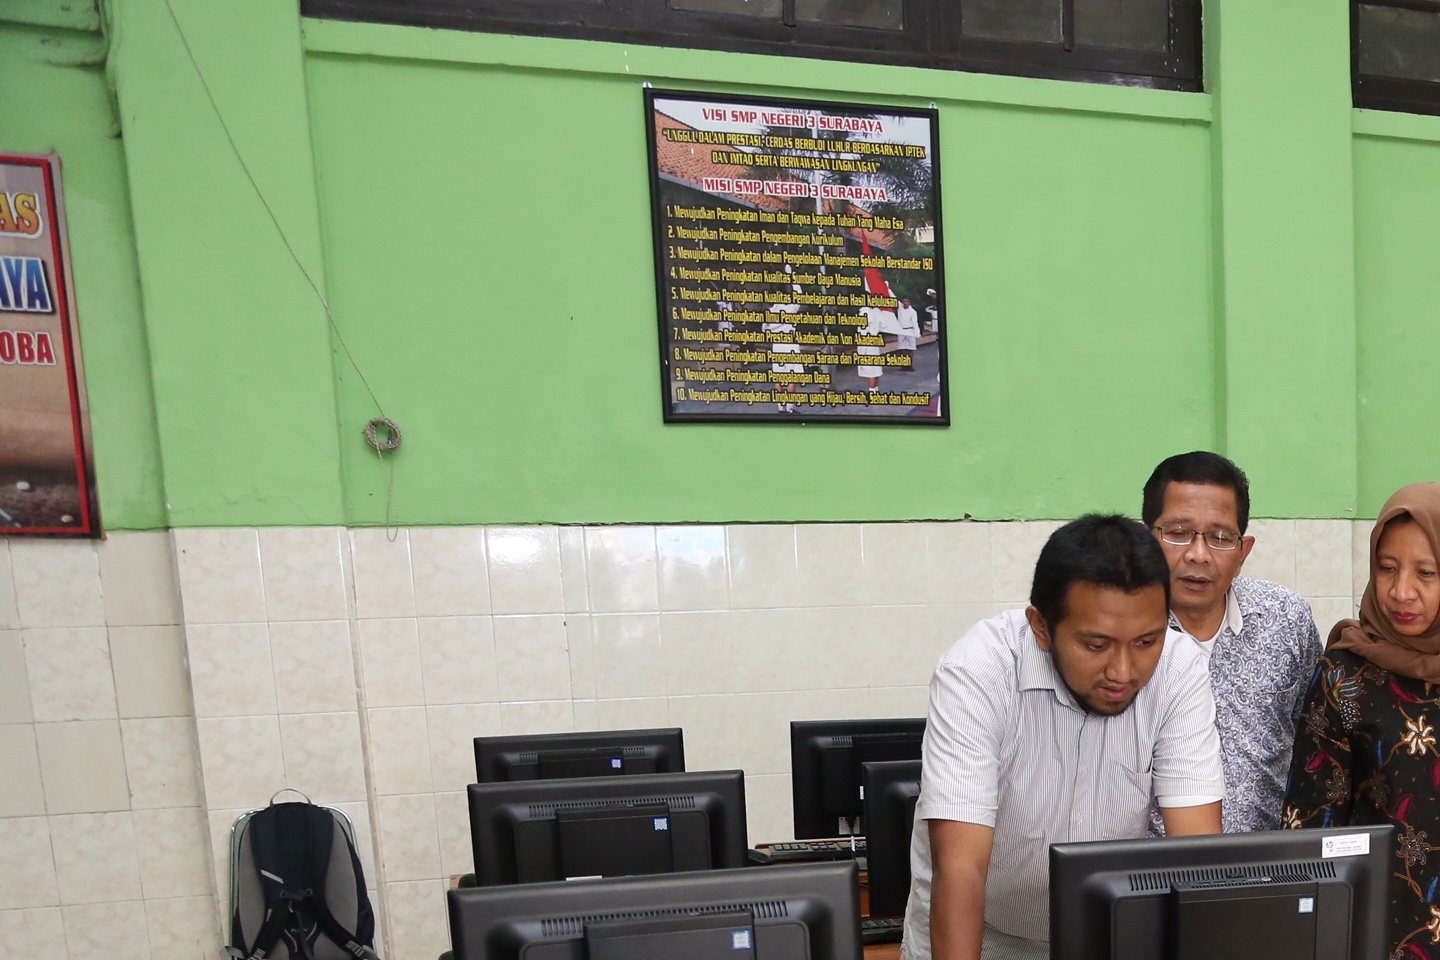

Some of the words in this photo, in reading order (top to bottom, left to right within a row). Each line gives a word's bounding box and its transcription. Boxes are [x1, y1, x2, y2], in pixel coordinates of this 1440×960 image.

[702, 108, 727, 121] VISI
[731, 110, 757, 123] SMP
[761, 112, 804, 127] NEGERI
[807, 115, 815, 128] 3
[819, 117, 884, 133] SURABAYA
[699, 130, 725, 144] DALAM
[765, 136, 793, 149] CERDAS
[795, 138, 826, 151] BERBUDI
[827, 140, 851, 153] LUHUR
[852, 141, 904, 157] BERDASARKAN
[905, 146, 926, 158] IPTEK
[712, 151, 728, 164] DAN
[755, 155, 778, 167] SERTA
[780, 156, 830, 170] BERWAWASAN
[704, 178, 731, 192] MISI
[735, 180, 761, 193] SMP
[765, 182, 807, 197] NEGERI
[811, 185, 819, 197] 3
[822, 186, 887, 201] SURABAYA
[667, 205, 673, 218] 1.
[674, 205, 716, 222] Mewujudkan
[716, 207, 758, 224] Peningkatan
[759, 210, 776, 223] Iman
[776, 211, 790, 223] dan
[790, 212, 811, 227] Taqwa
[812, 213, 836, 227] kepada
[837, 214, 856, 227] Tuhan
[857, 215, 873, 231] Yang
[874, 216, 892, 229] Maha
[892, 217, 904, 230] Esa
[668, 225, 675, 238] 2.
[676, 225, 718, 242] Mewujudkan
[719, 227, 760, 244] Peningkatan
[761, 230, 810, 247] Pengembangan
[811, 232, 844, 246] Kurikulum
[669, 246, 676, 259] 3.
[677, 246, 719, 262] Mewujudkan
[720, 248, 762, 265] Peningkatan
[762, 251, 782, 263] dalam
[783, 251, 822, 267] Pengelolaan
[823, 253, 860, 268] Manajemen
[860, 255, 885, 268] Sekolah
[886, 256, 921, 269] Berstandar
[922, 258, 933, 270] ISO
[670, 267, 678, 279] 4.
[679, 266, 720, 283] Mewujudkan
[721, 268, 763, 285] Peningkatan
[764, 270, 791, 283] Kualitas
[792, 272, 816, 284] Sumber
[817, 273, 834, 288] Daya
[835, 273, 861, 287] Manusia
[671, 287, 679, 300] 5.
[680, 287, 721, 303] Mewujudkan
[722, 289, 763, 305] Peningkatan
[764, 290, 791, 303] Kualitas
[792, 292, 836, 307] Pembelajaran
[837, 294, 849, 307] dan
[850, 294, 866, 307] Hasil
[867, 295, 898, 307] Kelulusan
[672, 307, 679, 320] 6.
[681, 307, 722, 324] Mewujudkan
[723, 309, 764, 325] Peningkatan
[765, 310, 780, 323] Ilmu
[781, 312, 823, 326] Pengetahuan
[824, 313, 836, 325] dan
[837, 313, 868, 328] Teknologi
[673, 328, 680, 340] 7.
[682, 327, 723, 344] Mewujudkan
[724, 329, 765, 345] Peningkatan
[766, 330, 794, 343] Prestasi
[795, 331, 826, 344] Akademik
[827, 333, 839, 345] dan
[840, 333, 853, 345] Non
[854, 334, 885, 346] Akademik
[674, 347, 682, 360] 8.
[683, 348, 724, 364] Mewujudkan
[725, 349, 766, 364] Peningkatan
[767, 350, 815, 366] Pengembangan
[816, 352, 839, 364] Sarana
[840, 353, 852, 365] dan
[853, 353, 885, 366] Prasarana
[887, 353, 911, 366] Sekolah
[675, 368, 683, 380] 9.
[684, 368, 725, 384] Mewujudkan
[726, 369, 767, 385] Peningkatan
[768, 370, 812, 386] Penggalangan
[813, 371, 830, 384] Dana
[676, 388, 687, 401] 10.
[688, 388, 729, 404] Mewujudkan
[730, 389, 771, 405] Peningkatan
[771, 389, 808, 405] Lingkungan
[809, 392, 825, 406] yang
[869, 392, 888, 404] Sehat
[889, 393, 901, 404] dan
[902, 393, 929, 405] Kondusif
